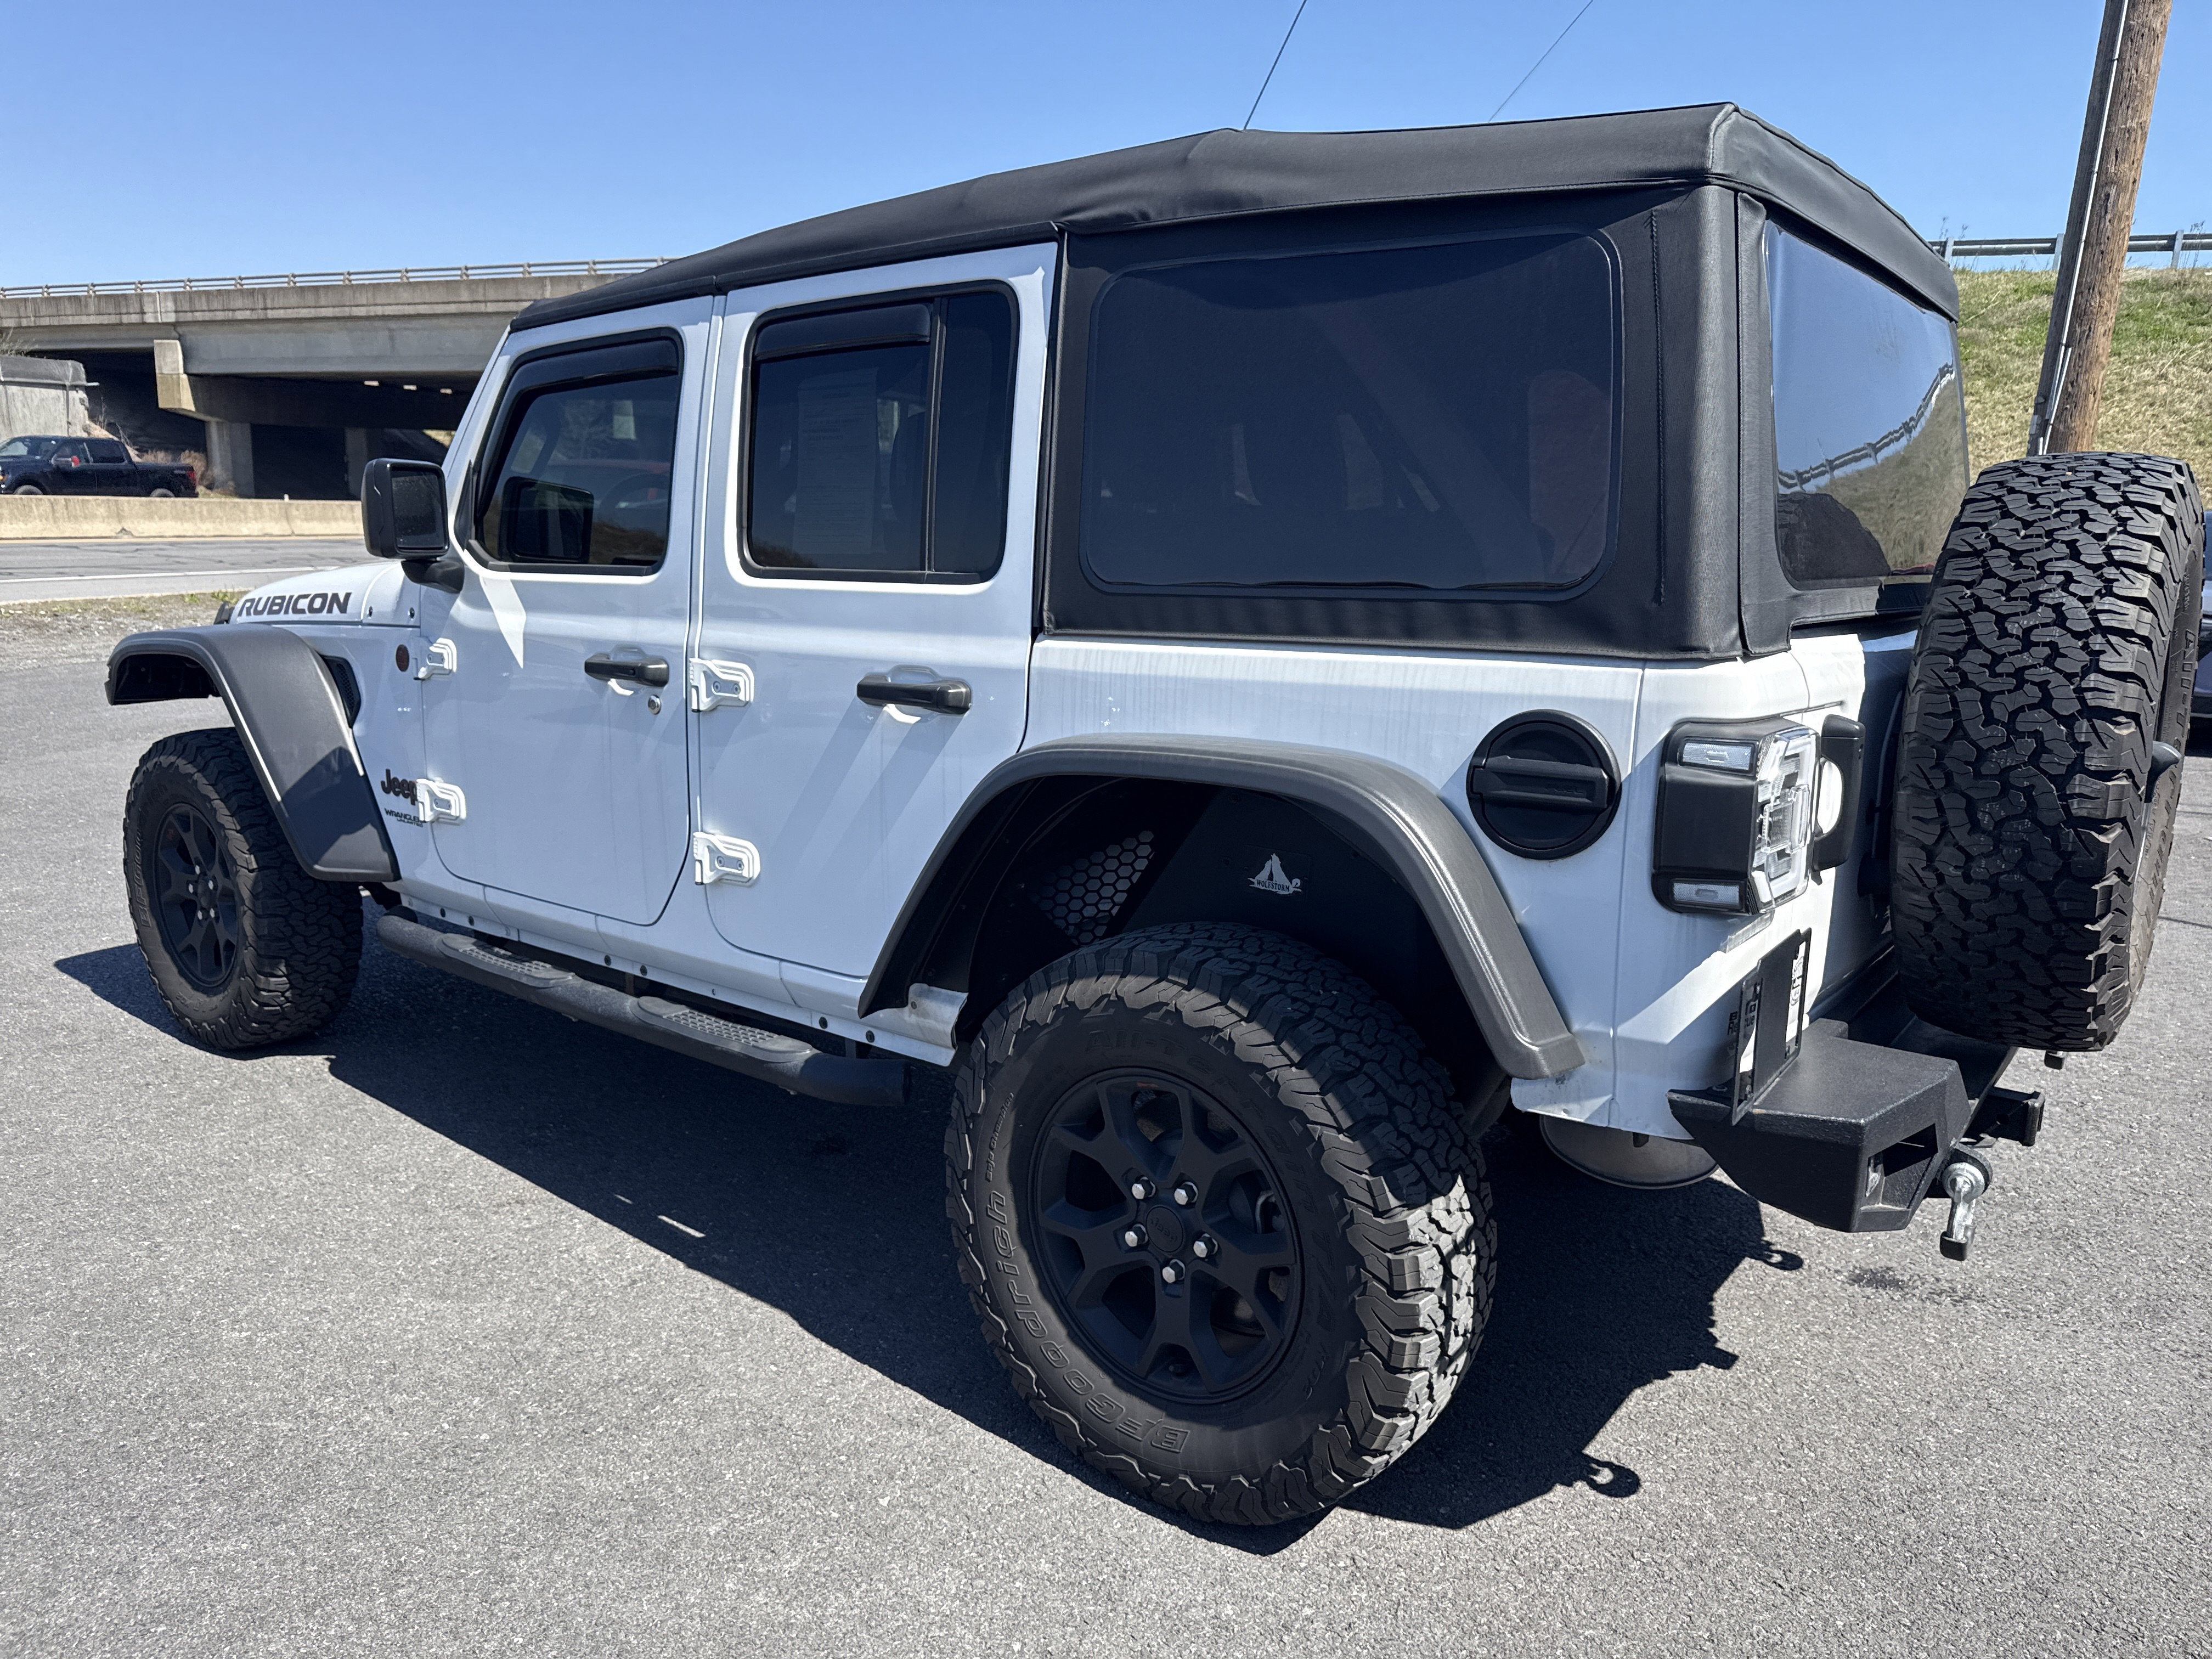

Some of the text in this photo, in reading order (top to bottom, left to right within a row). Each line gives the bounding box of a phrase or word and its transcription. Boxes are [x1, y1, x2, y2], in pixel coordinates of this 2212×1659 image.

[238, 592, 352, 617] RUBICON
[1256, 879, 1290, 893] WOLFSTORM
[985, 1189, 1190, 1454] BFGoodrich
